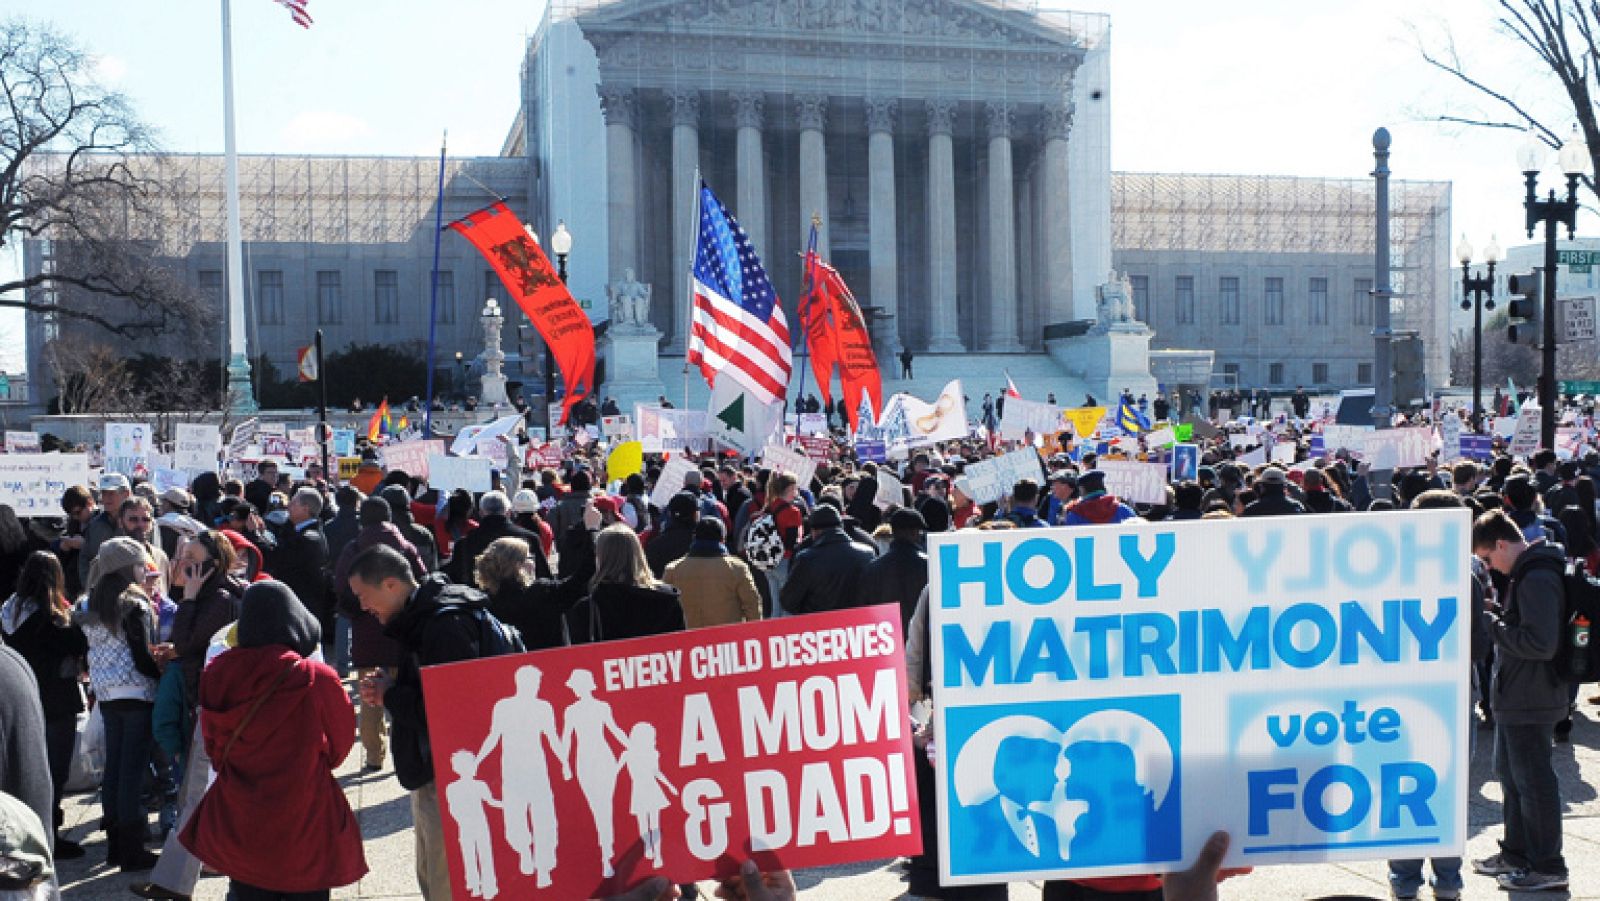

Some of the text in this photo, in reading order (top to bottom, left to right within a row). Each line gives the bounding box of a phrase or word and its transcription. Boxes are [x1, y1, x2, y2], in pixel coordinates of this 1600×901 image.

[1560, 251, 1592, 264] FIRST
[939, 532, 1175, 607] HOLY
[603, 620, 895, 692] EVERY CHILD DESERVES
[942, 597, 1457, 688] MATRIMONY
[678, 668, 901, 768] A MOM
[1266, 700, 1401, 748] vote
[681, 779, 731, 861] &
[743, 752, 911, 852] DAD!
[1247, 761, 1437, 837] FOR
